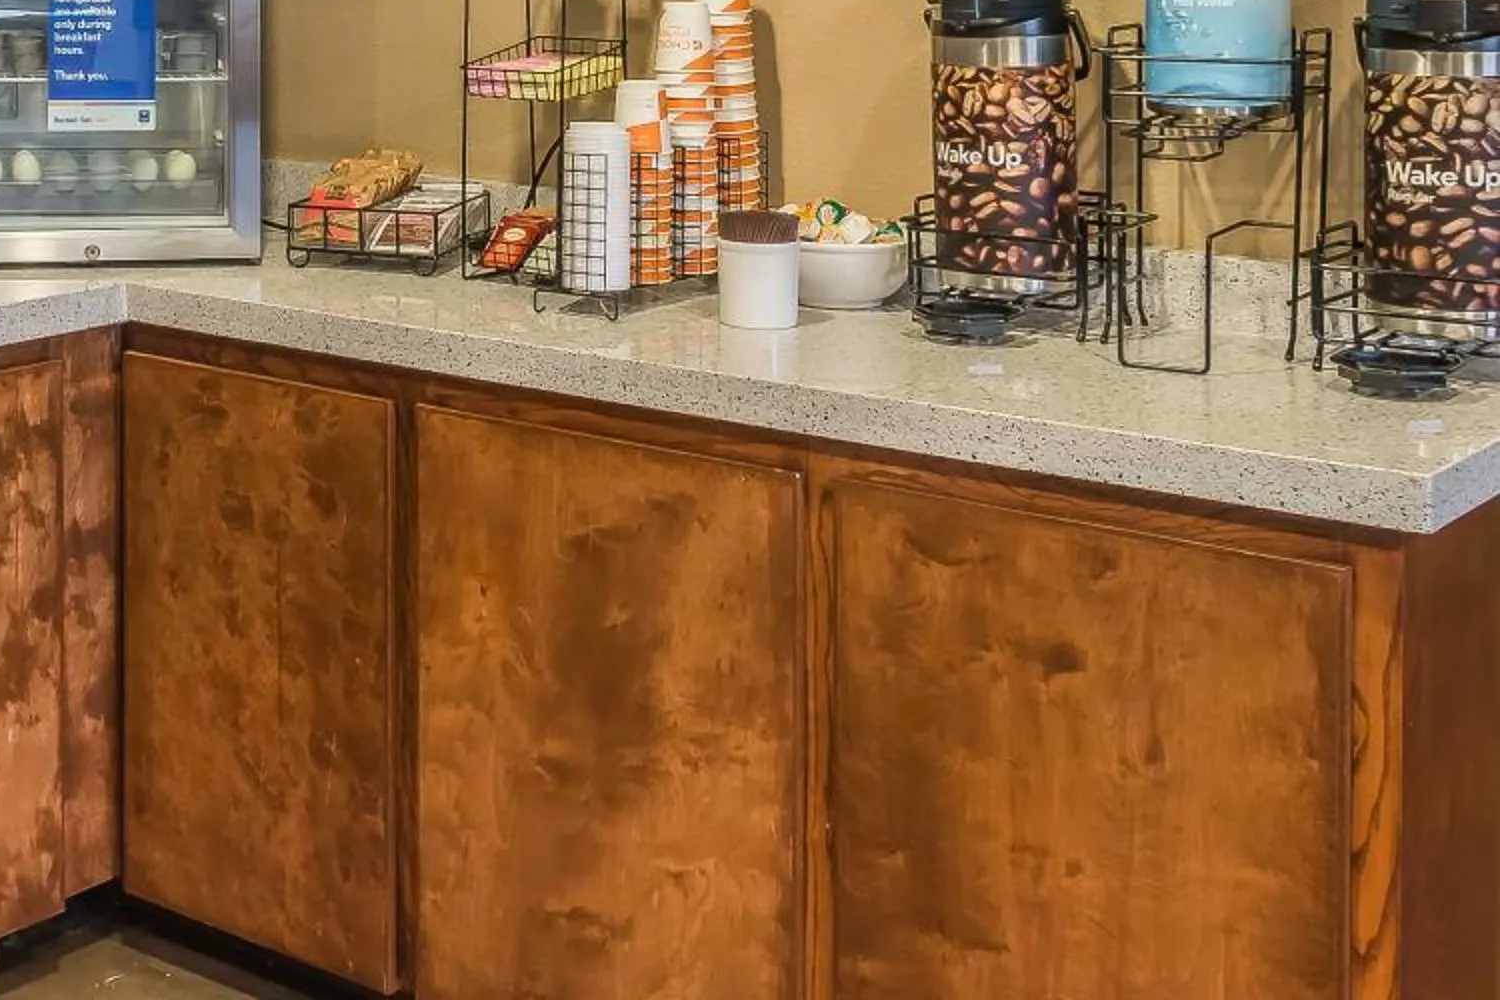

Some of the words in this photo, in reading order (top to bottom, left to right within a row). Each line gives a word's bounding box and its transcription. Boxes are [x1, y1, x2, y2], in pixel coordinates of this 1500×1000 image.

[54, 19, 76, 31] only
[78, 19, 112, 31] during
[54, 32, 102, 42] breakfast
[54, 69, 86, 81] Thank
[936, 141, 983, 165] Wake
[988, 145, 1023, 170] Up
[1385, 160, 1459, 187] Wake
[1465, 165, 1500, 192] Up
